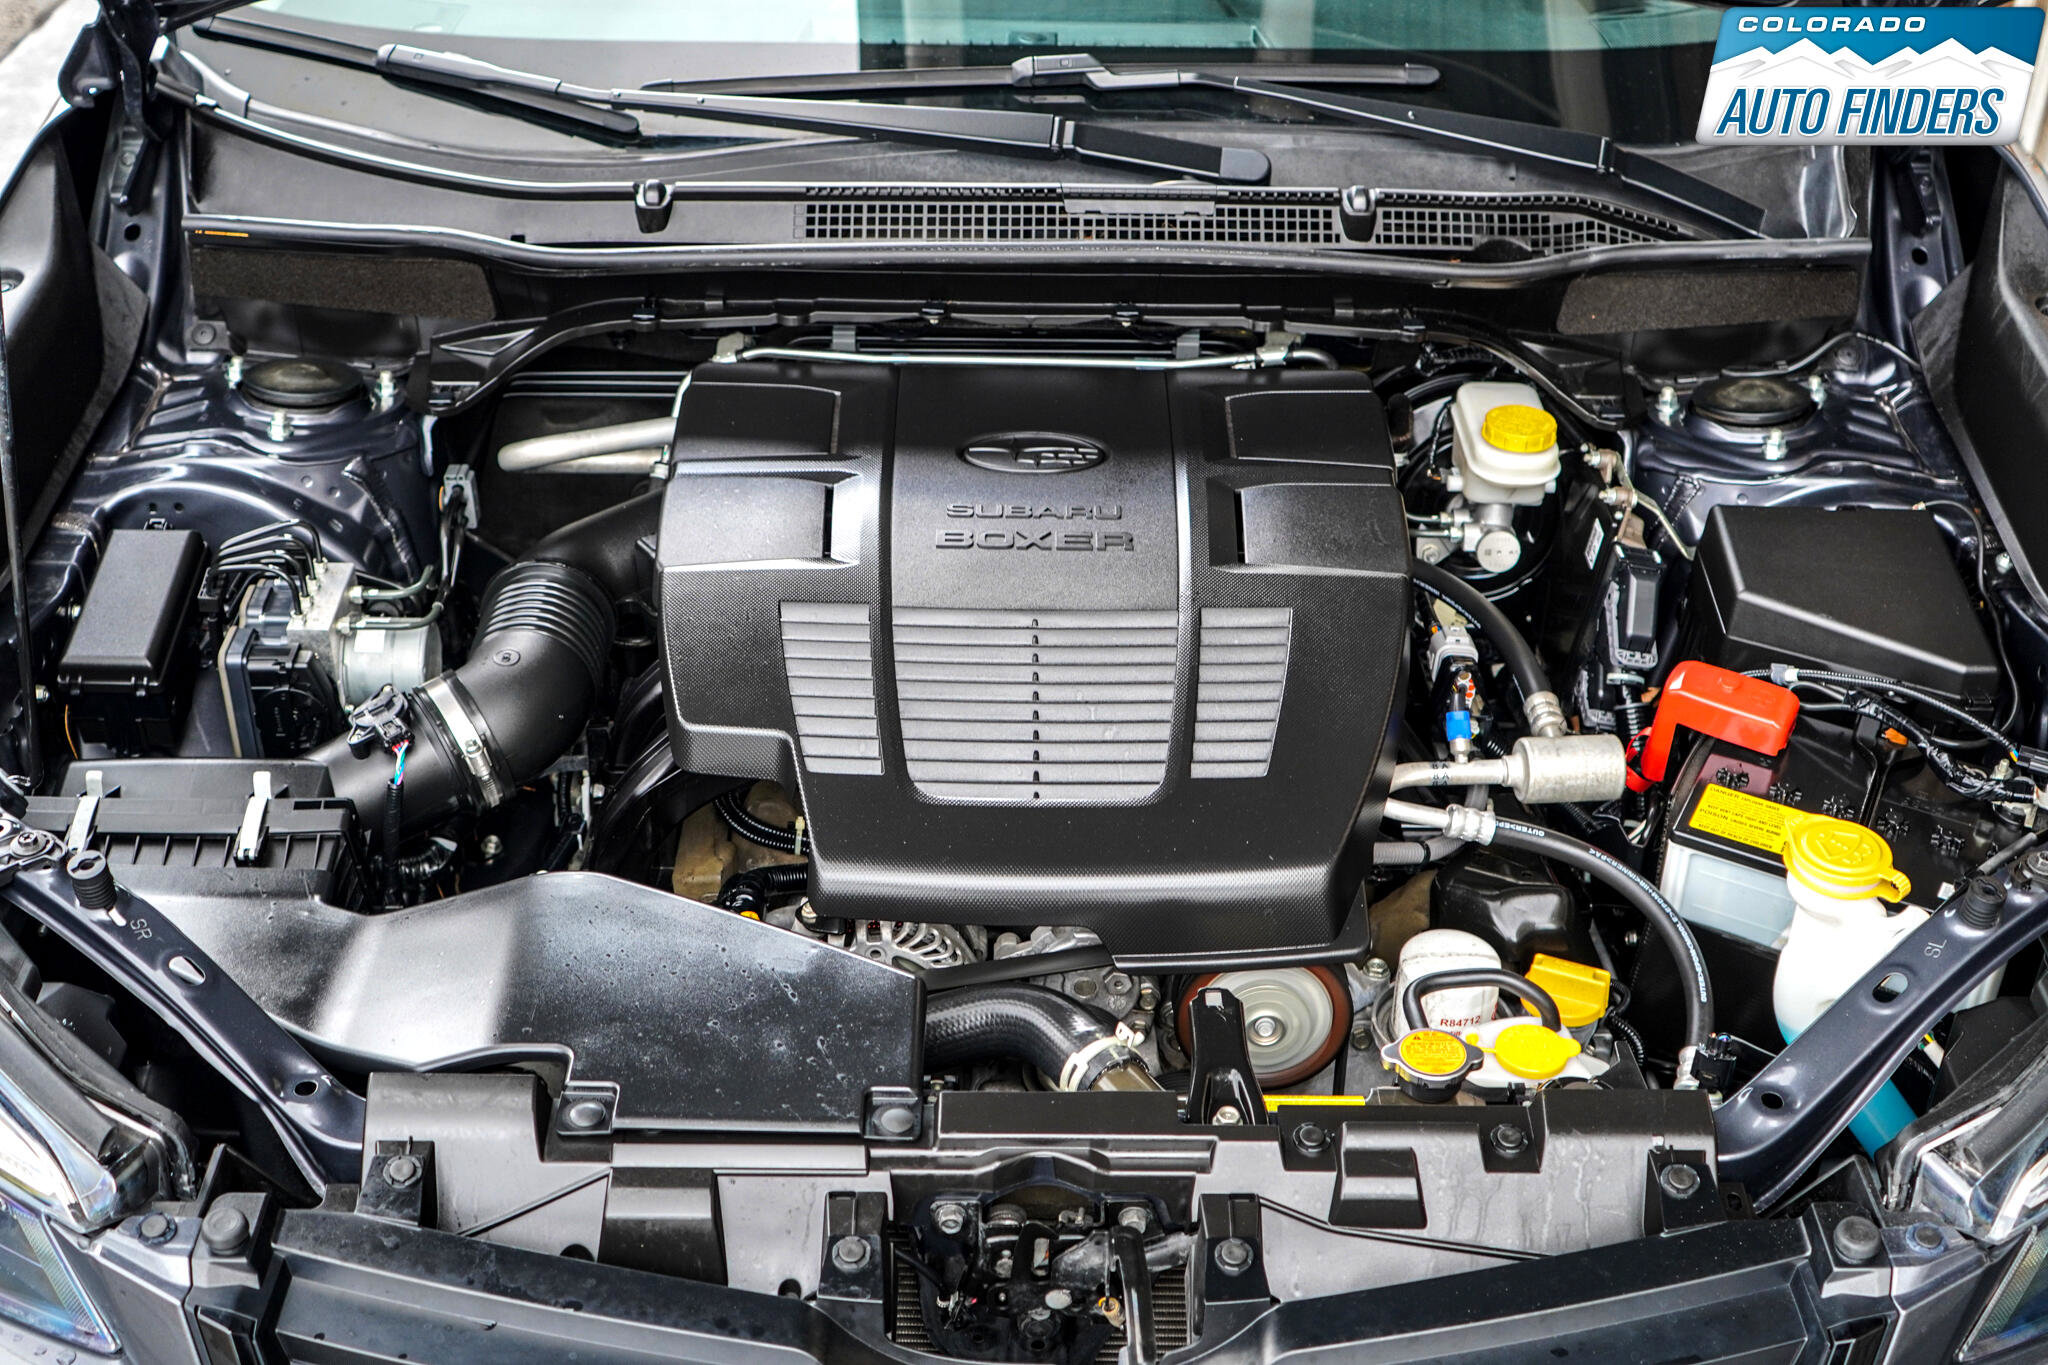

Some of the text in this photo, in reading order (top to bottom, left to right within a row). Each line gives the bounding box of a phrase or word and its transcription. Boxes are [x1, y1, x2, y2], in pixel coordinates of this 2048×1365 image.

[946, 503, 1123, 520] SUBARU
[935, 530, 1135, 551] BOXER
[130, 918, 152, 940] SR
[1924, 939, 1947, 958] SL
[1439, 1015, 1482, 1028] R84712
